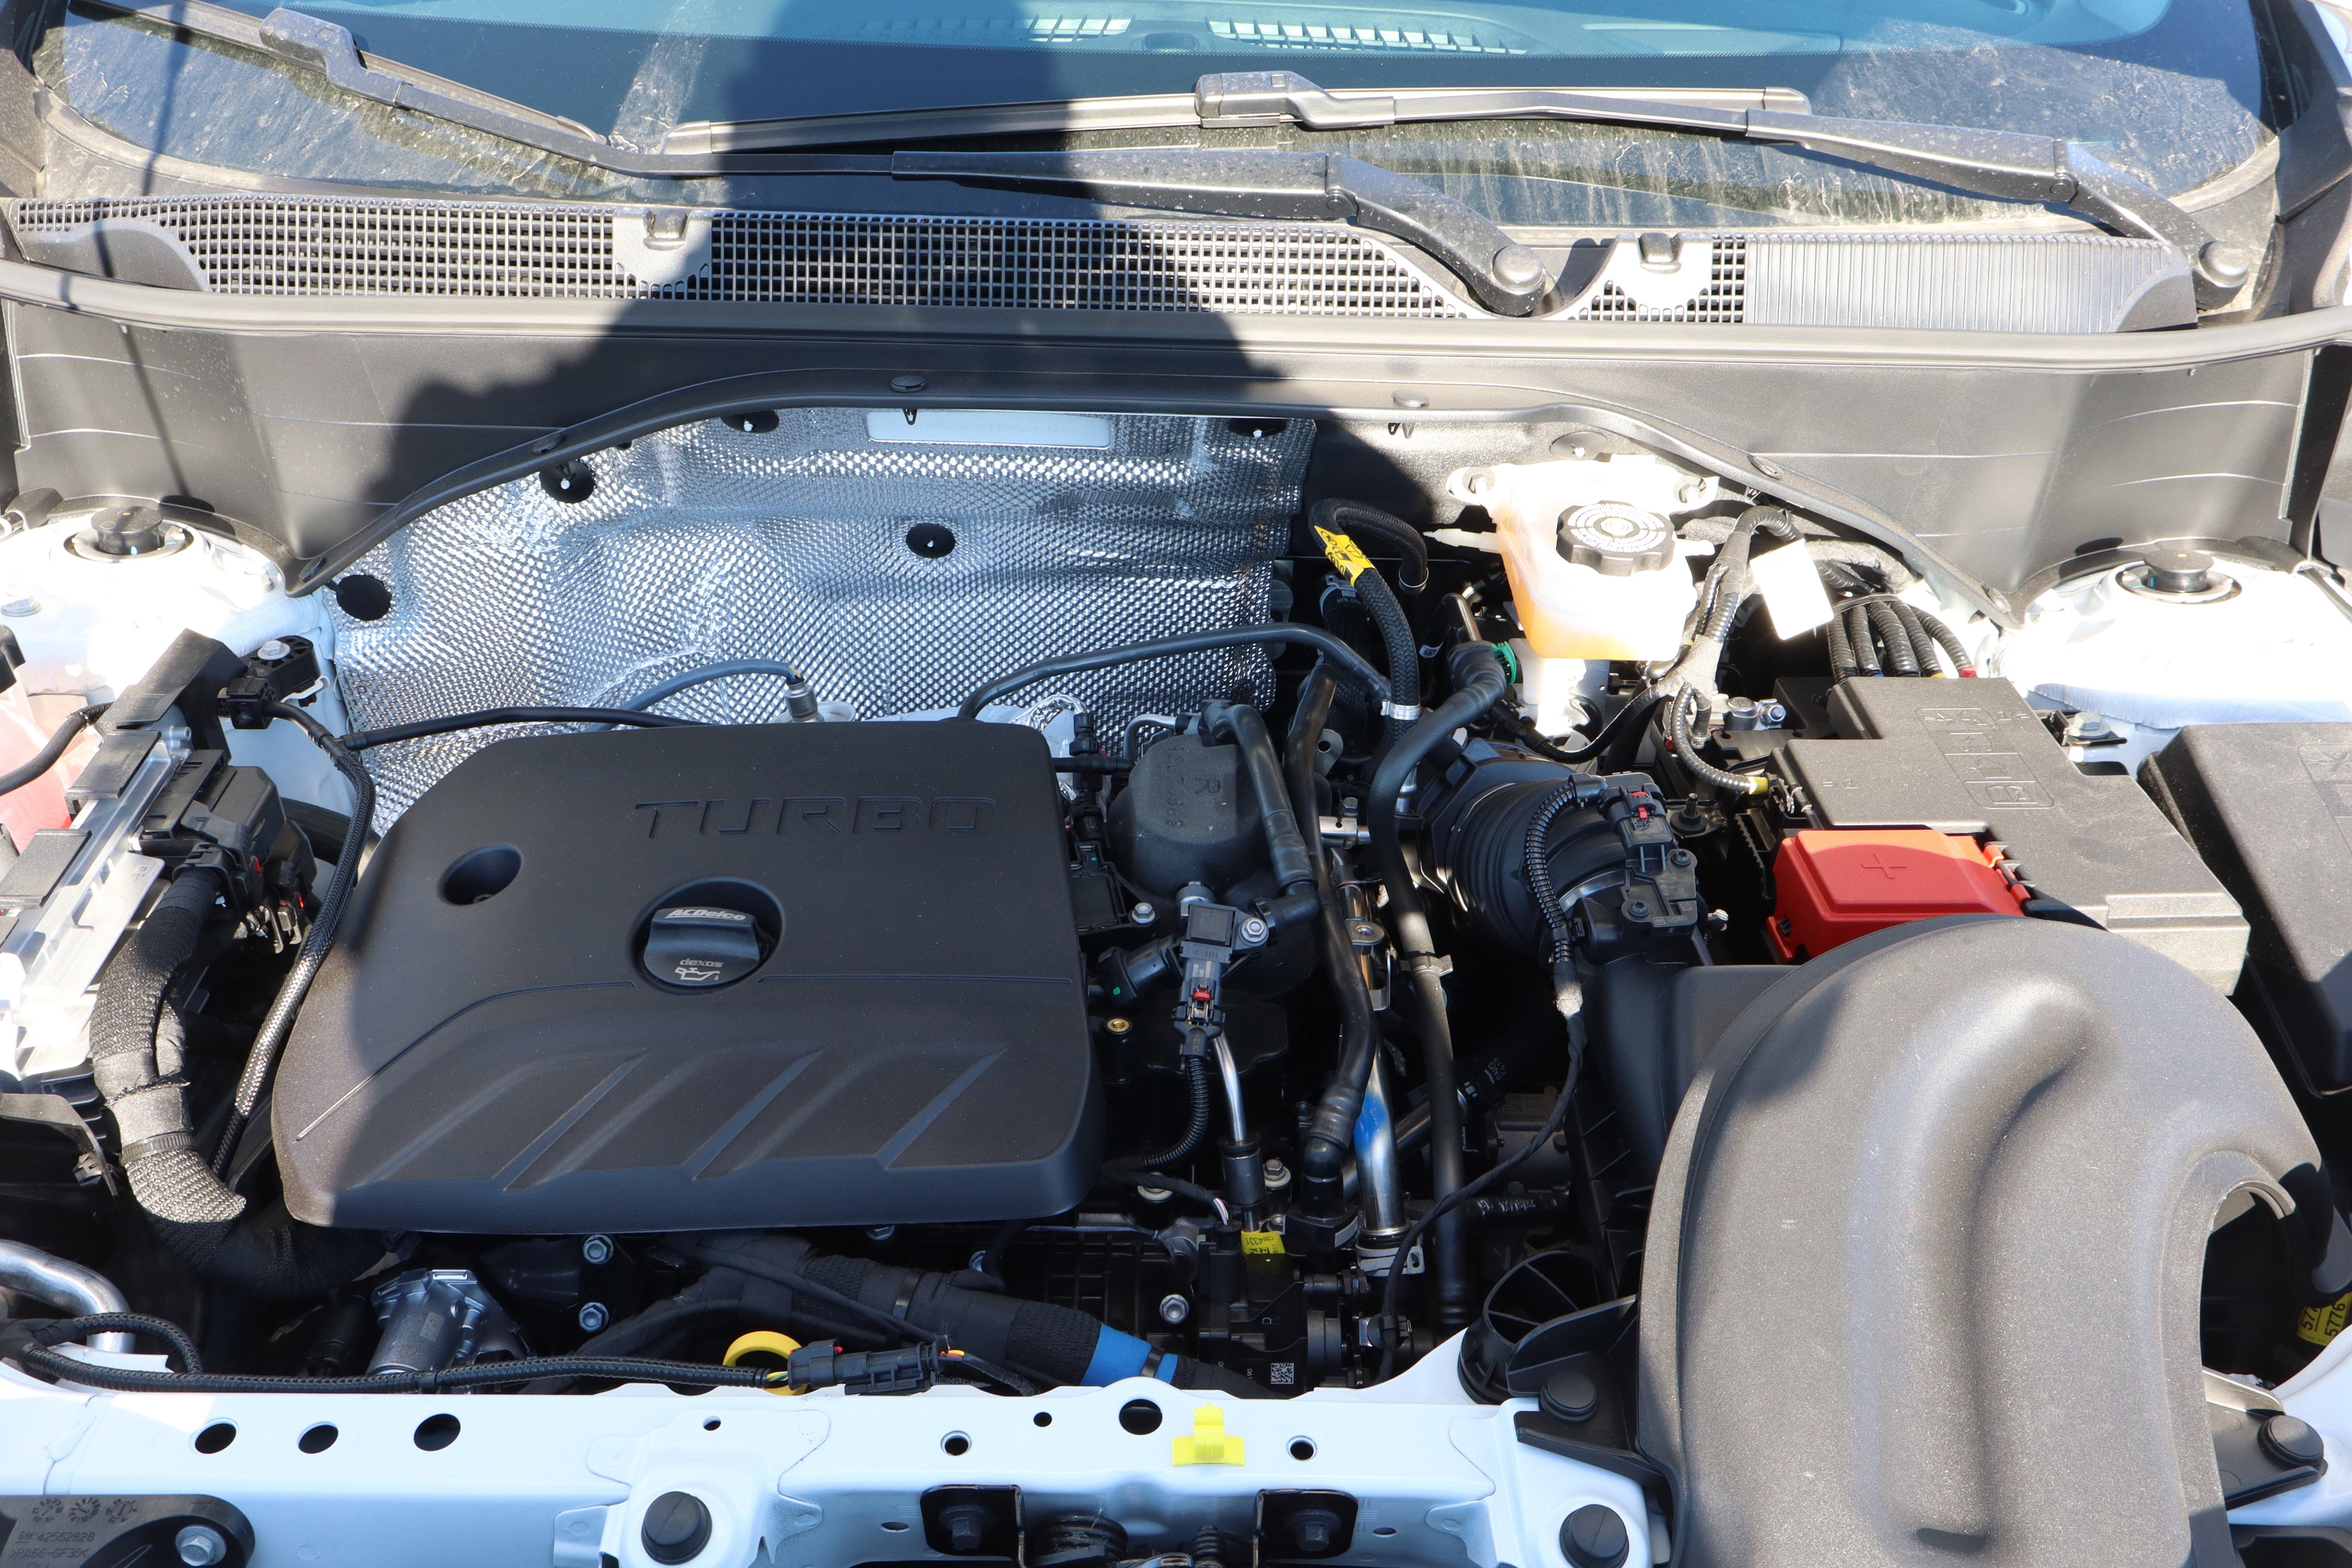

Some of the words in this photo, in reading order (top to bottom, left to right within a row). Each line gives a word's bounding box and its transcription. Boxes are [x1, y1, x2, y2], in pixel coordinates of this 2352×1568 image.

[635, 797, 996, 838] TURBO
[665, 909, 746, 920] ACDelco
[679, 958, 724, 968] dexos
